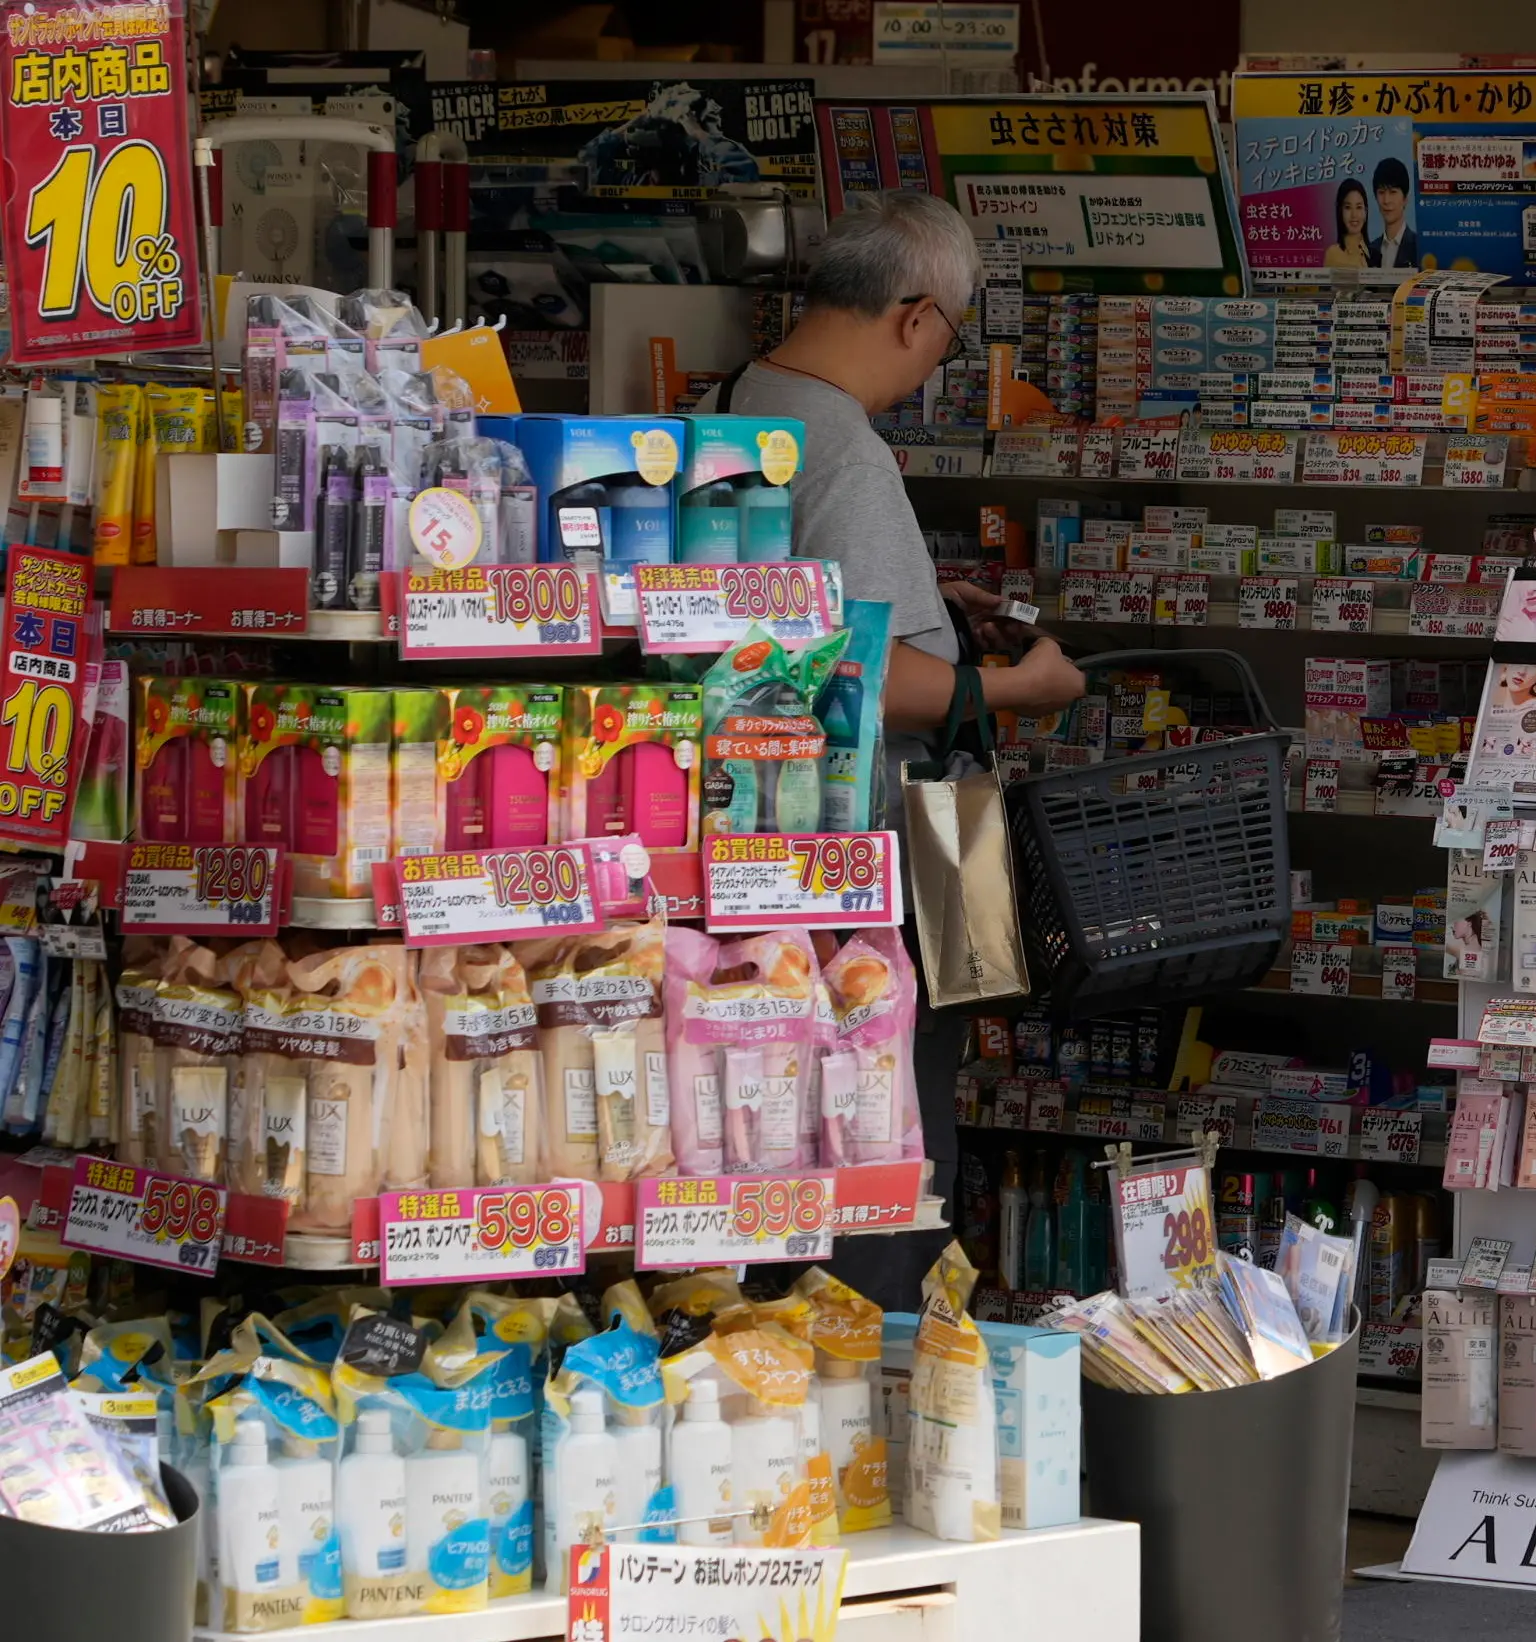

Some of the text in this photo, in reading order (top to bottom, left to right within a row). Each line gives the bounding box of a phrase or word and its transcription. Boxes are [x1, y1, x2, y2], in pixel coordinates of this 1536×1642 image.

[11, 41, 171, 105] 店内商品
[432, 94, 495, 121] BLACK
[499, 103, 644, 130] うわさの黒いシャンプー
[744, 92, 812, 118] BLACK
[50, 105, 128, 139] 本日
[988, 111, 1160, 148] 虫さされ対策
[1246, 119, 1384, 163] ステロイドの力で
[1252, 158, 1366, 190] イッキに治そ。
[978, 200, 1038, 215] アラントイン
[1246, 204, 1292, 220] 虫さされ
[1095, 231, 1145, 247] リドカイン
[1247, 225, 1322, 241] あせも・かぶれ
[112, 279, 182, 323] OFF
[20, 556, 84, 579] サンドラッグ
[408, 569, 485, 591] お買得品
[640, 566, 717, 590] 好評発売中
[492, 568, 584, 624] 1800
[722, 567, 813, 618] 2800
[131, 609, 202, 628] お買得コーナー
[230, 609, 303, 629] お買得コーナー
[13, 612, 77, 657] 本日
[538, 622, 580, 643] 1980
[13, 654, 72, 680] 店内商品
[130, 846, 193, 870] お買得品
[711, 838, 784, 861] お買得品
[195, 847, 269, 902] 1280
[403, 855, 483, 881] お買得品
[792, 838, 878, 891] 798
[486, 850, 580, 906] 1280
[841, 890, 873, 911] 877
[540, 904, 584, 925] 1408
[608, 1070, 634, 1087] LUX
[182, 1107, 217, 1124] LUX
[267, 1115, 293, 1132] LUX
[1459, 1110, 1495, 1123] ALLIE
[86, 1163, 135, 1192] 特選品
[1120, 1174, 1178, 1203] 在庫限り
[657, 1180, 718, 1205] 特選品
[143, 1178, 219, 1243] 598
[398, 1193, 461, 1219] 特選品
[732, 1178, 826, 1237] 598
[833, 1203, 911, 1226] お買得コーナー
[477, 1190, 572, 1250] 598
[646, 1208, 728, 1234] ラックス ポンプペア
[388, 1223, 471, 1250] ラックス ポンプペア
[785, 1236, 821, 1256] 657
[1163, 1209, 1206, 1270] 298
[533, 1246, 568, 1268] 657
[1428, 1311, 1493, 1326] ALLIE
[374, 1322, 417, 1347] お買い得
[1471, 1489, 1511, 1507] Think
[619, 1554, 824, 1588] パンテーン お試しポンプ2ステップ
[360, 1584, 425, 1603] PANTENE
[570, 1587, 609, 1597] SUNDRUG
[252, 1595, 303, 1617] PANTENE
[620, 1613, 740, 1635] サロンクオリティの髪へ
